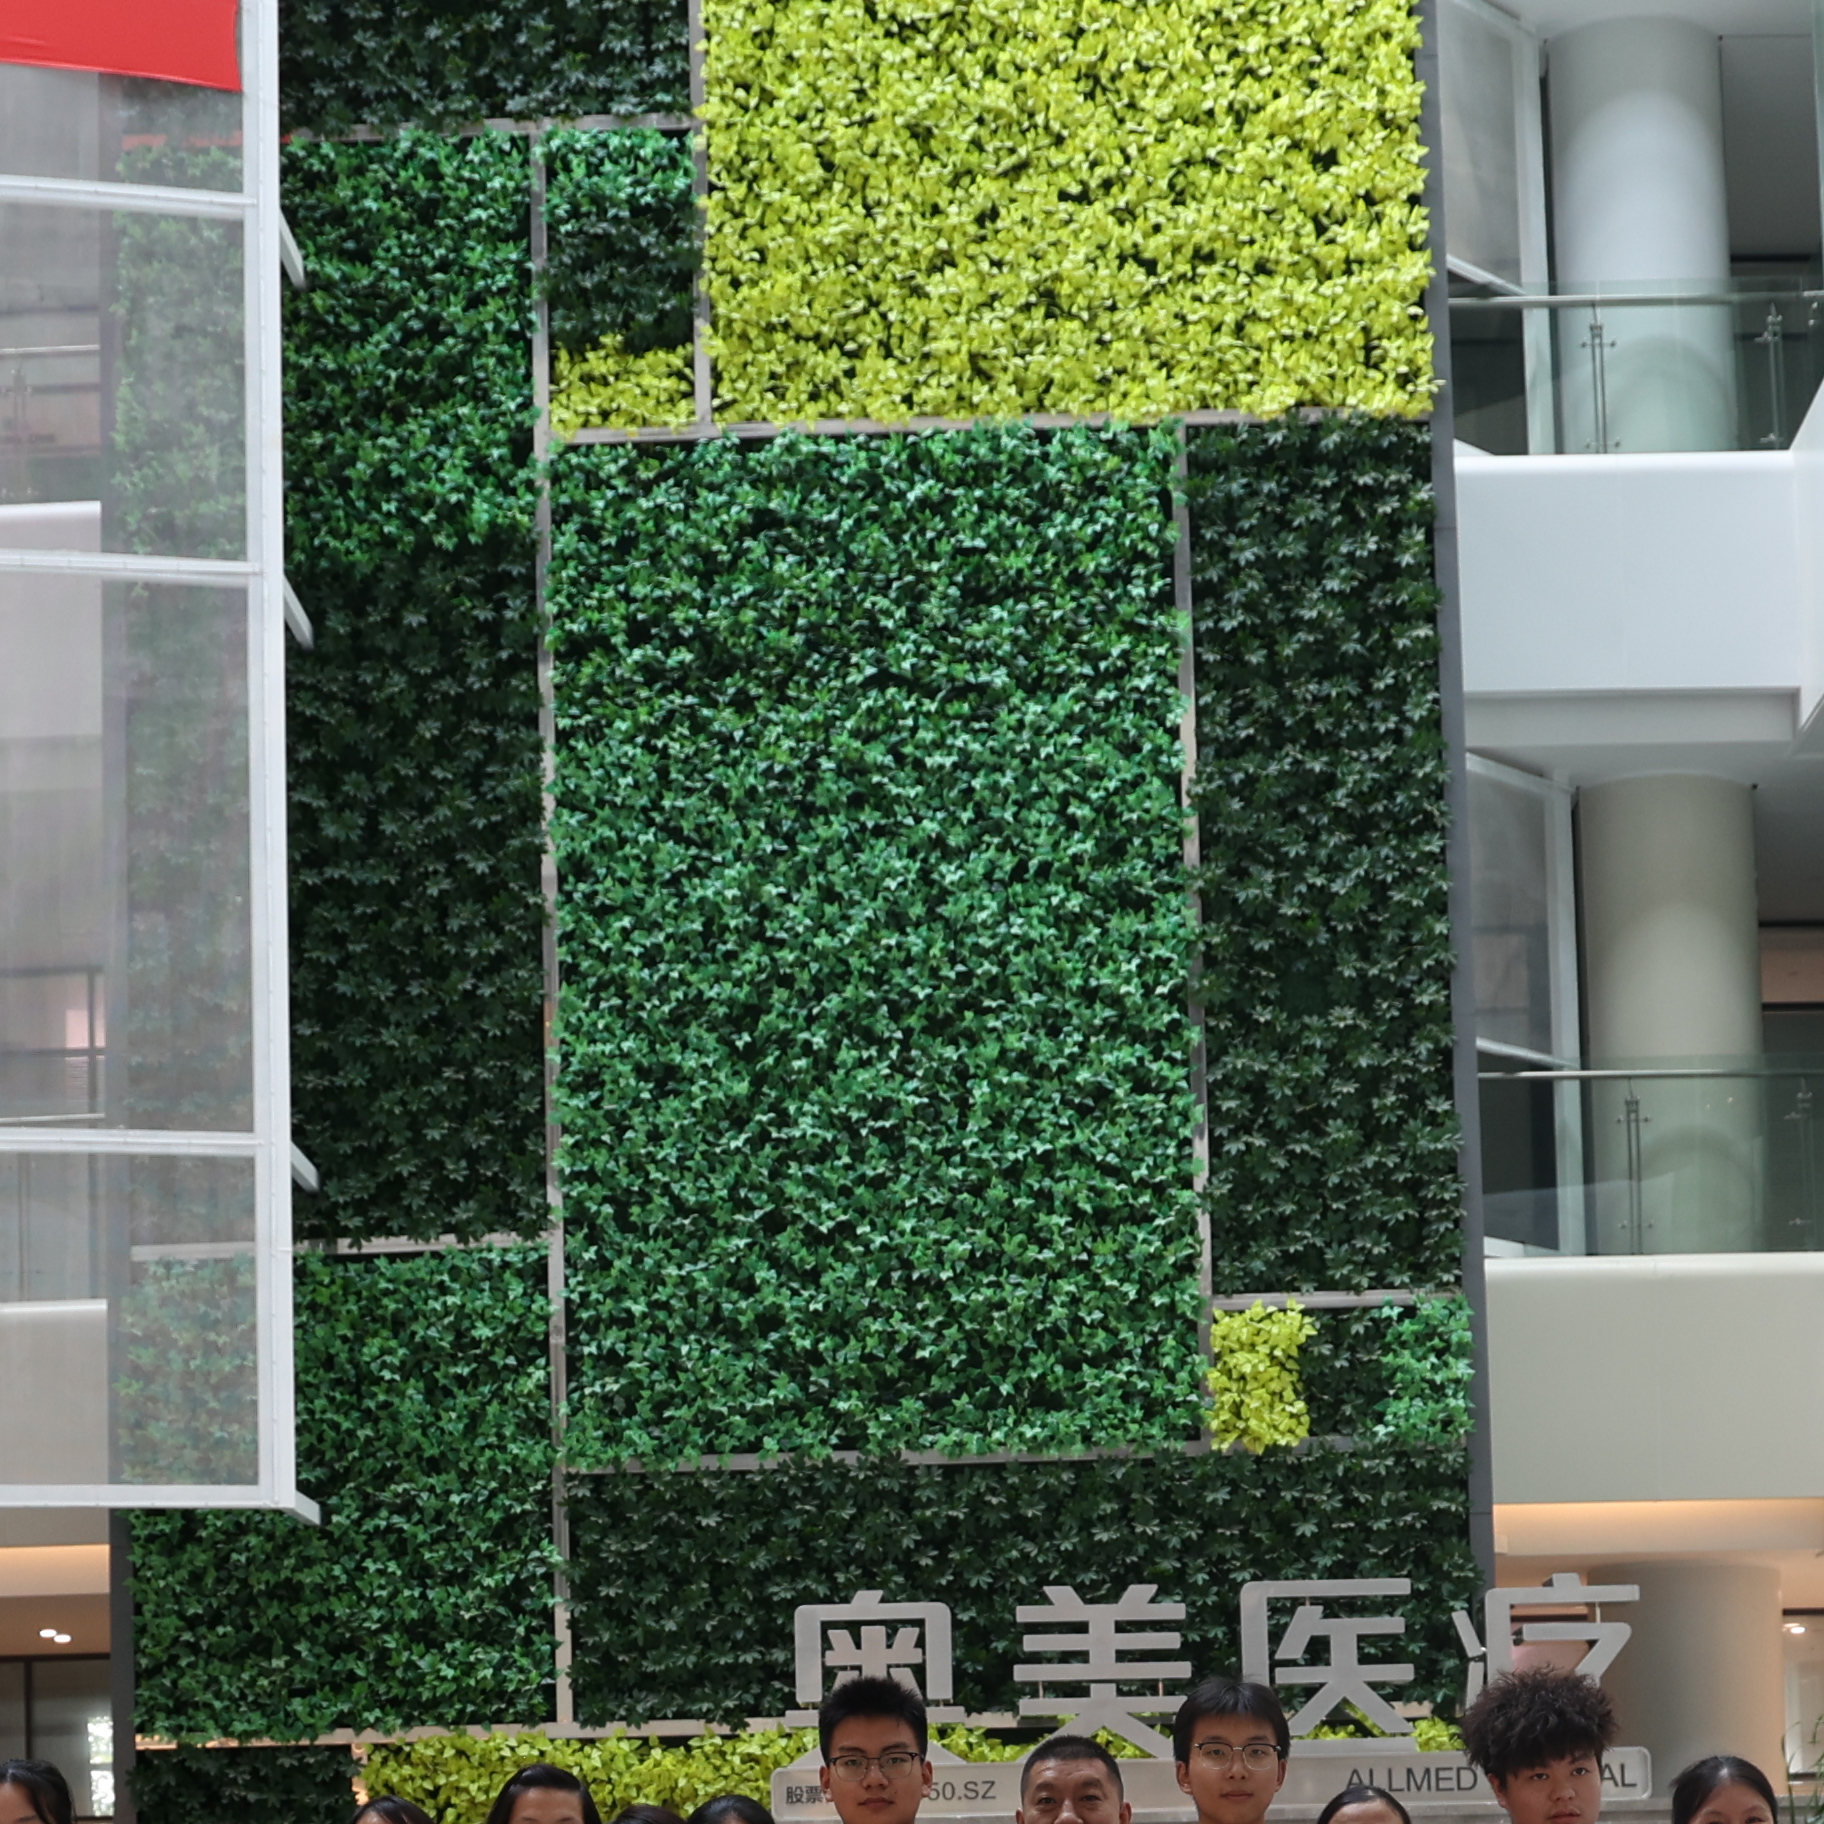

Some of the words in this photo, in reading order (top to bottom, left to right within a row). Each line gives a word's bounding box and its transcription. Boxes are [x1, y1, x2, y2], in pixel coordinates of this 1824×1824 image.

[1346, 1766, 1478, 1792] ALLMED
[785, 1785, 826, 1806] 股票
[928, 1780, 996, 1801] 50.SZ
